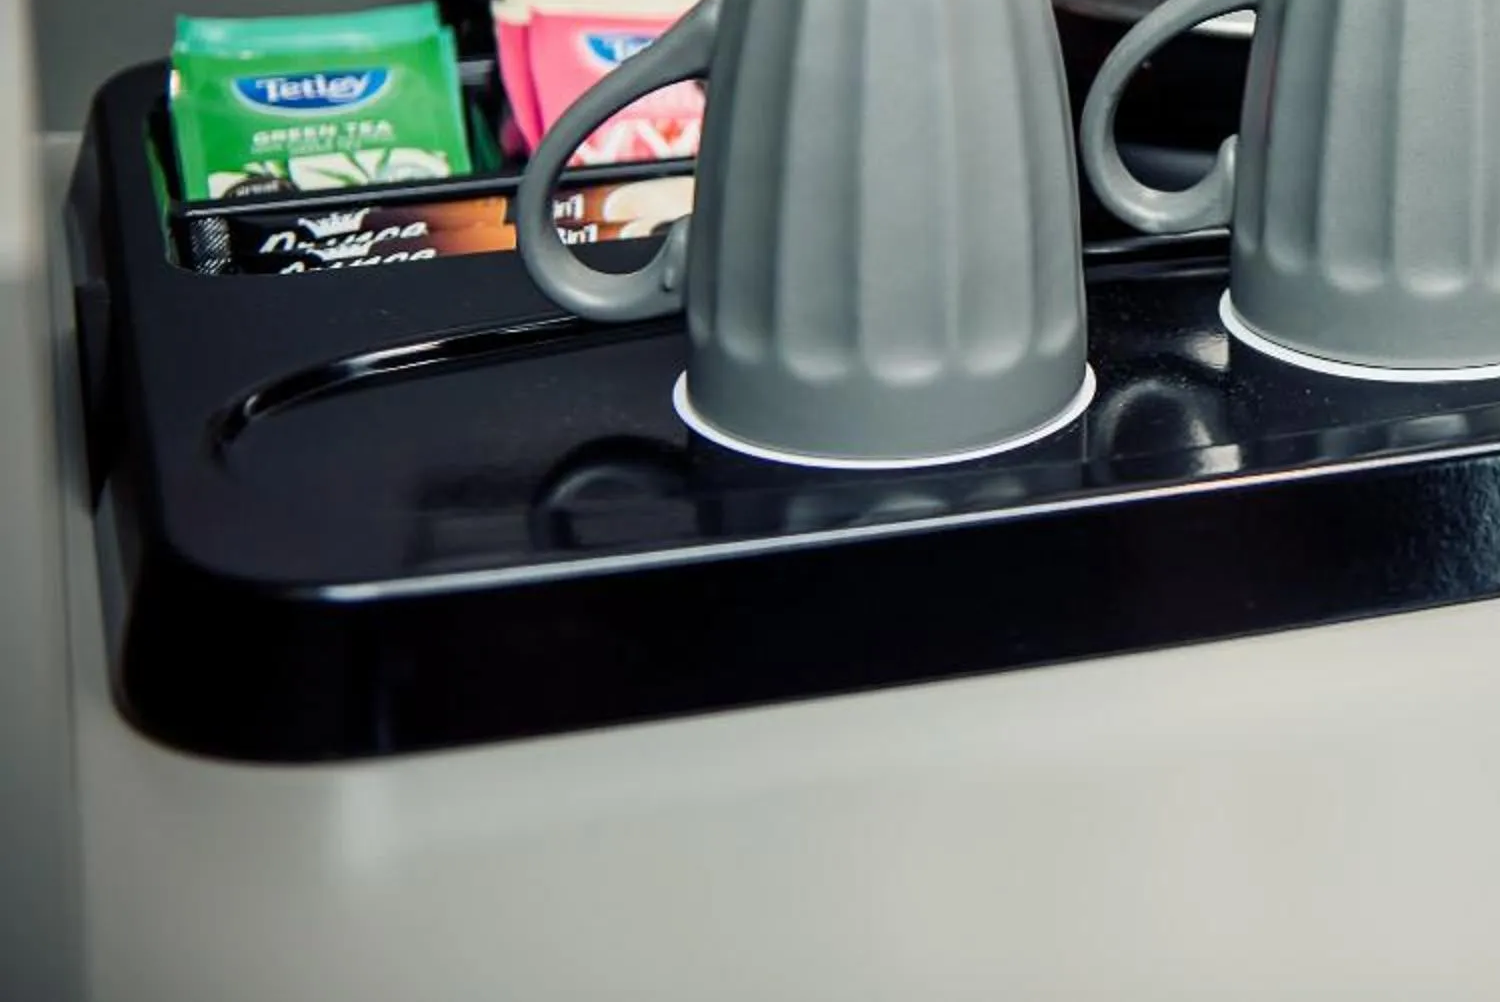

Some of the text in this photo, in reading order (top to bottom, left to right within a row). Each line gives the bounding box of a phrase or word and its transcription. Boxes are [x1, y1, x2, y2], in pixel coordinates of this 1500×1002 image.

[256, 72, 370, 102] Tetley
[253, 119, 393, 147] GREEN TEA
